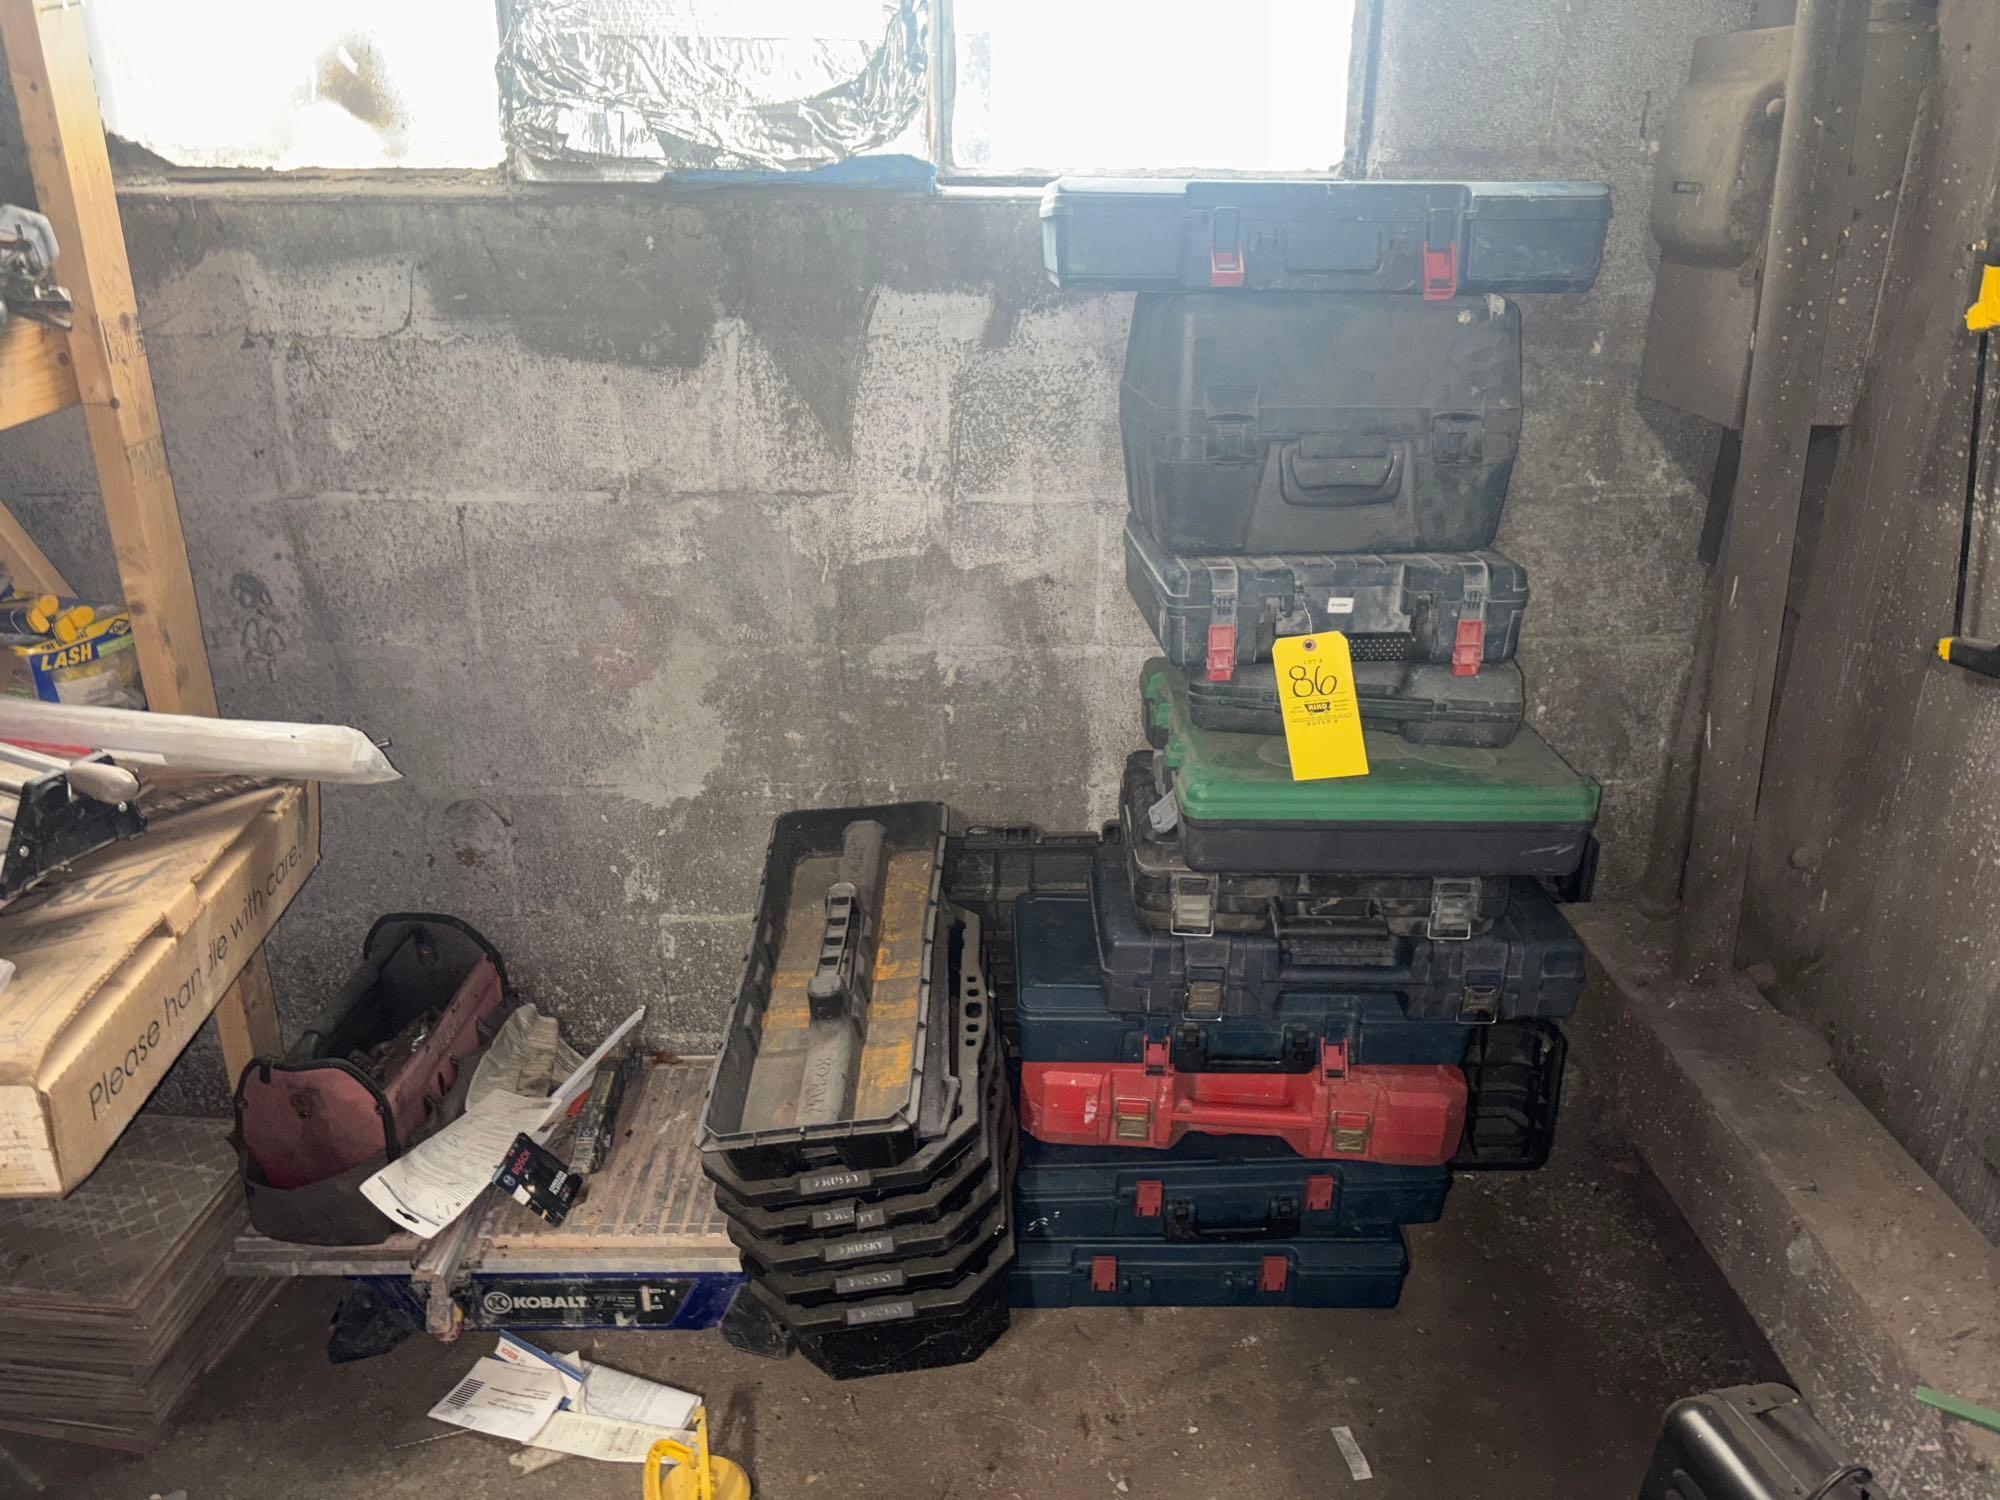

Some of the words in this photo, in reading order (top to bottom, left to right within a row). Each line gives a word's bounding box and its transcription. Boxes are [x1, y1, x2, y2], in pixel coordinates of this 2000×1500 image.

[41, 642, 92, 671] LASH
[1289, 665, 1337, 697] 86
[89, 1020, 160, 1121] Please
[230, 889, 264, 940] with
[266, 845, 302, 896] care.
[511, 1149, 532, 1176] BOSCH
[822, 1174, 859, 1187] HUSKY
[846, 1241, 883, 1253] HUSKY
[514, 1296, 588, 1309] KOBALT
